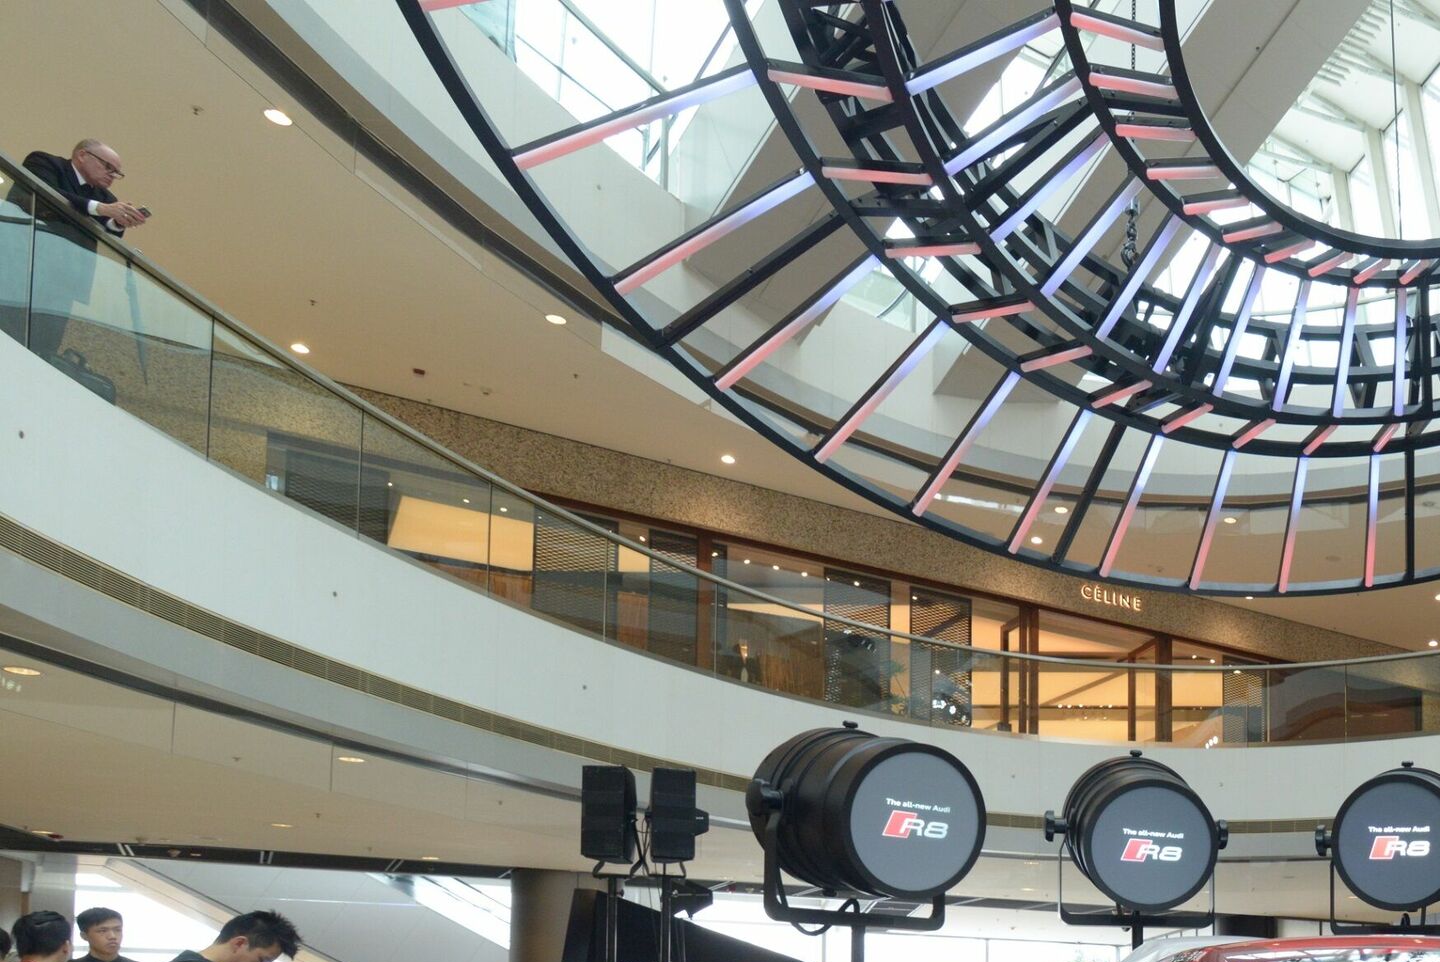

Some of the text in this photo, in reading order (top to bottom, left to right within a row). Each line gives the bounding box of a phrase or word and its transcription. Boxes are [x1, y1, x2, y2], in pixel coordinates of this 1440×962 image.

[886, 798, 901, 806] The
[932, 804, 951, 813] Audi
[899, 818, 949, 839] R8
[1123, 828, 1137, 836] The
[1166, 831, 1184, 839] Audi
[1411, 825, 1431, 833] Audi
[1136, 844, 1182, 861] R8
[1383, 840, 1430, 857] R8
